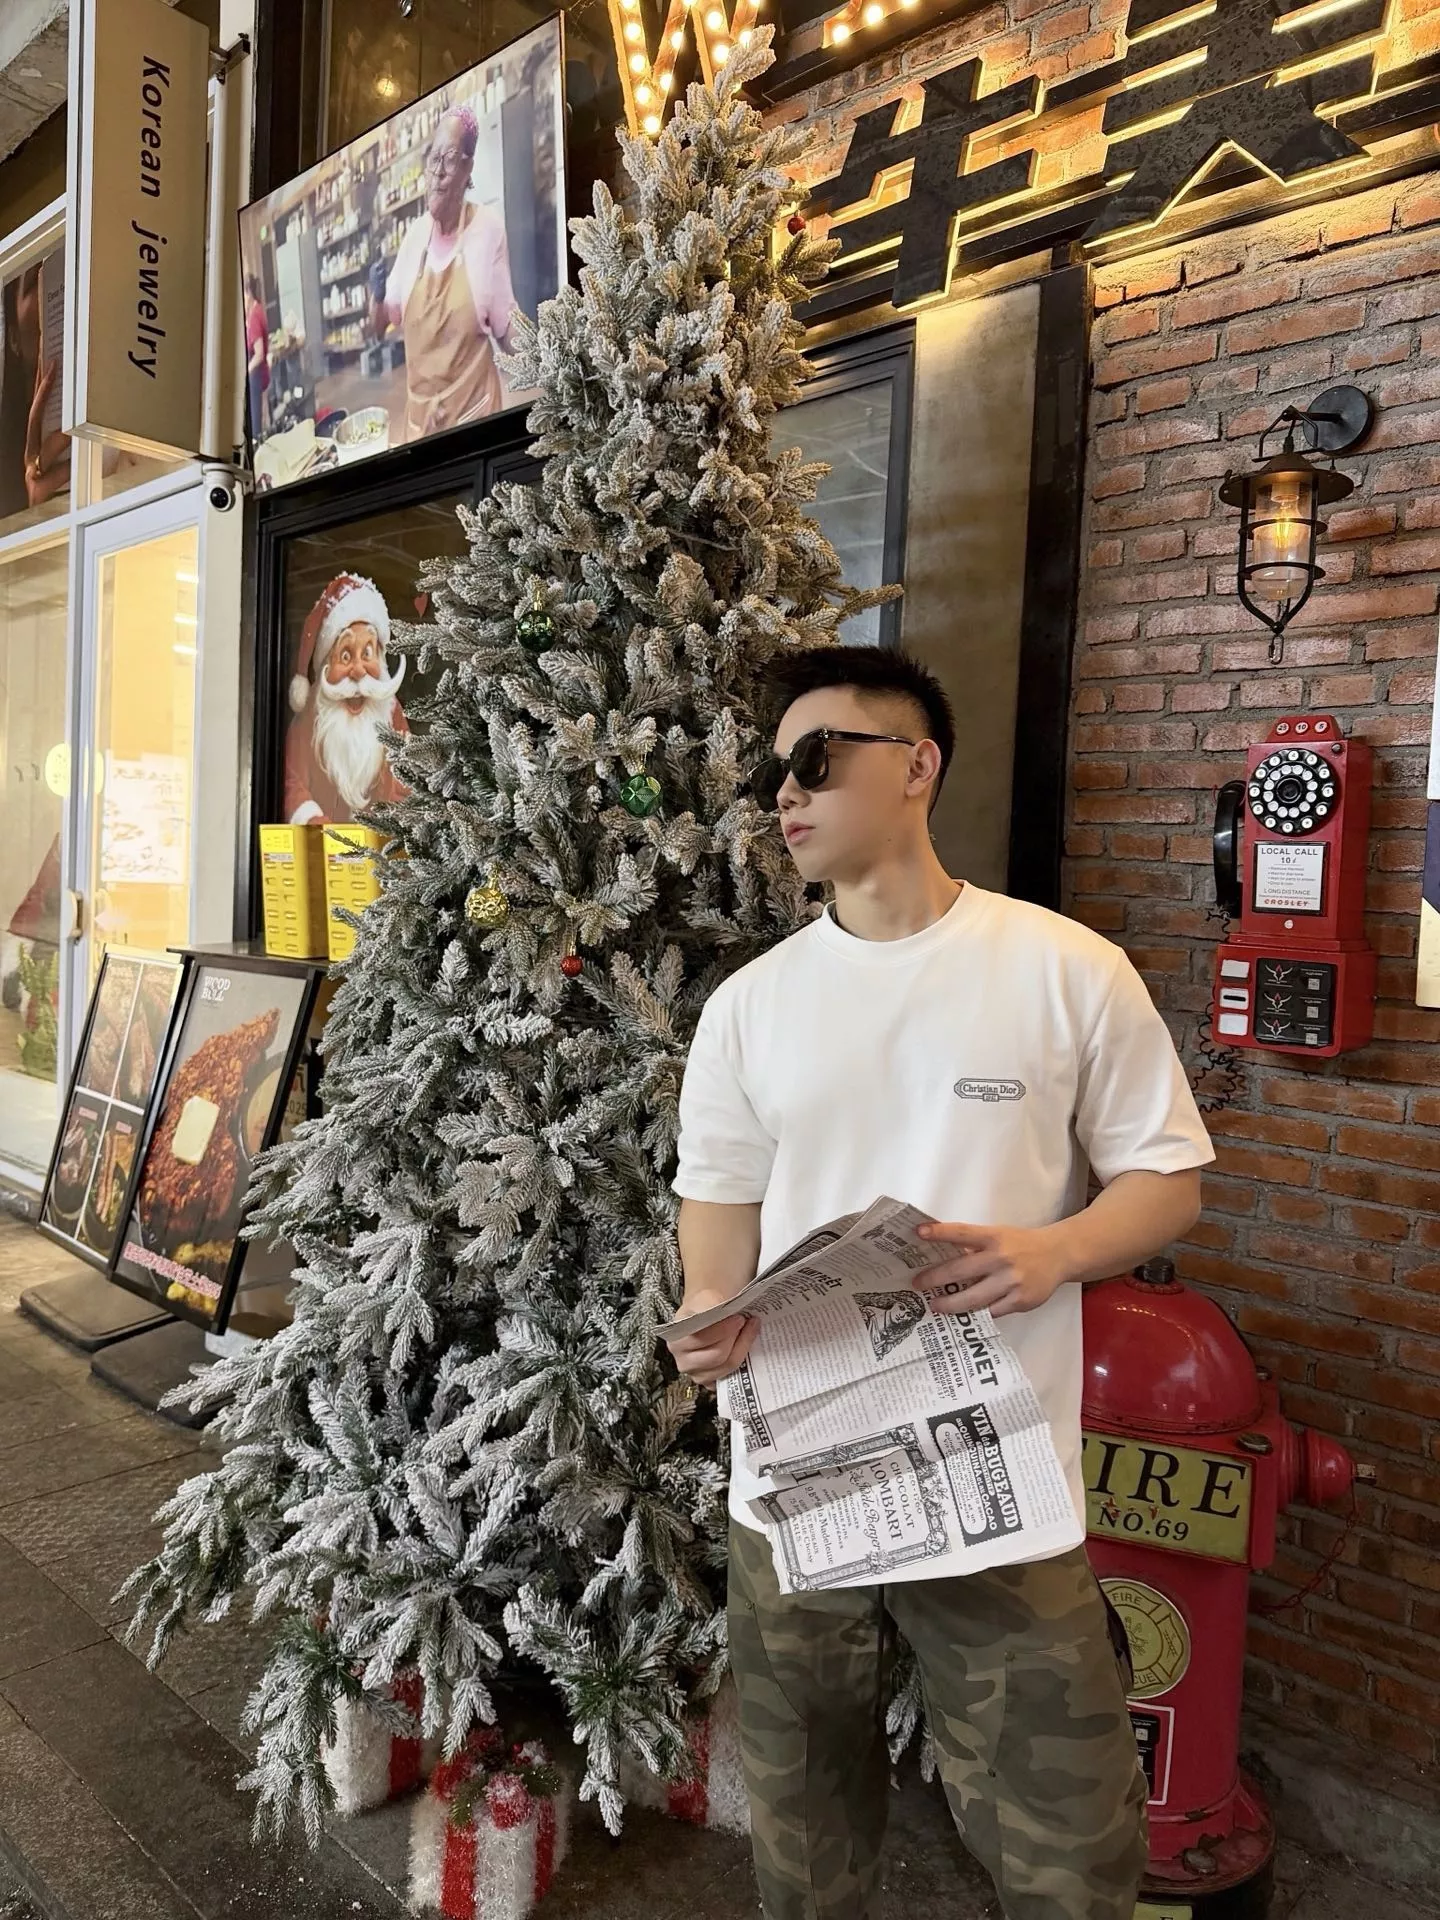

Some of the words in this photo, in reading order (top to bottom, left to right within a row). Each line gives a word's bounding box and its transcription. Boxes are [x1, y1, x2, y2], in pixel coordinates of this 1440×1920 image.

[141, 55, 170, 198] Korean
[128, 220, 168, 380] jewelry
[963, 1084, 998, 1094] Christian
[1000, 1084, 1017, 1094] Dior
[741, 1372, 751, 1390] NON
[942, 1335, 952, 1350] DES
[947, 1352, 964, 1388] CHEVEUX
[870, 1462, 903, 1540] LOMBART
[890, 1462, 915, 1528] CHOCOLAT
[959, 1425, 983, 1476] QUINQUINA
[981, 1493, 998, 1530] CACAO
[970, 1408, 993, 1437] VIN
[985, 1445, 1020, 1528] BUGEAUD
[1082, 1438, 1247, 1519] IRE
[1097, 1506, 1189, 1541] NO.69
[1112, 1592, 1142, 1605] FIRE
